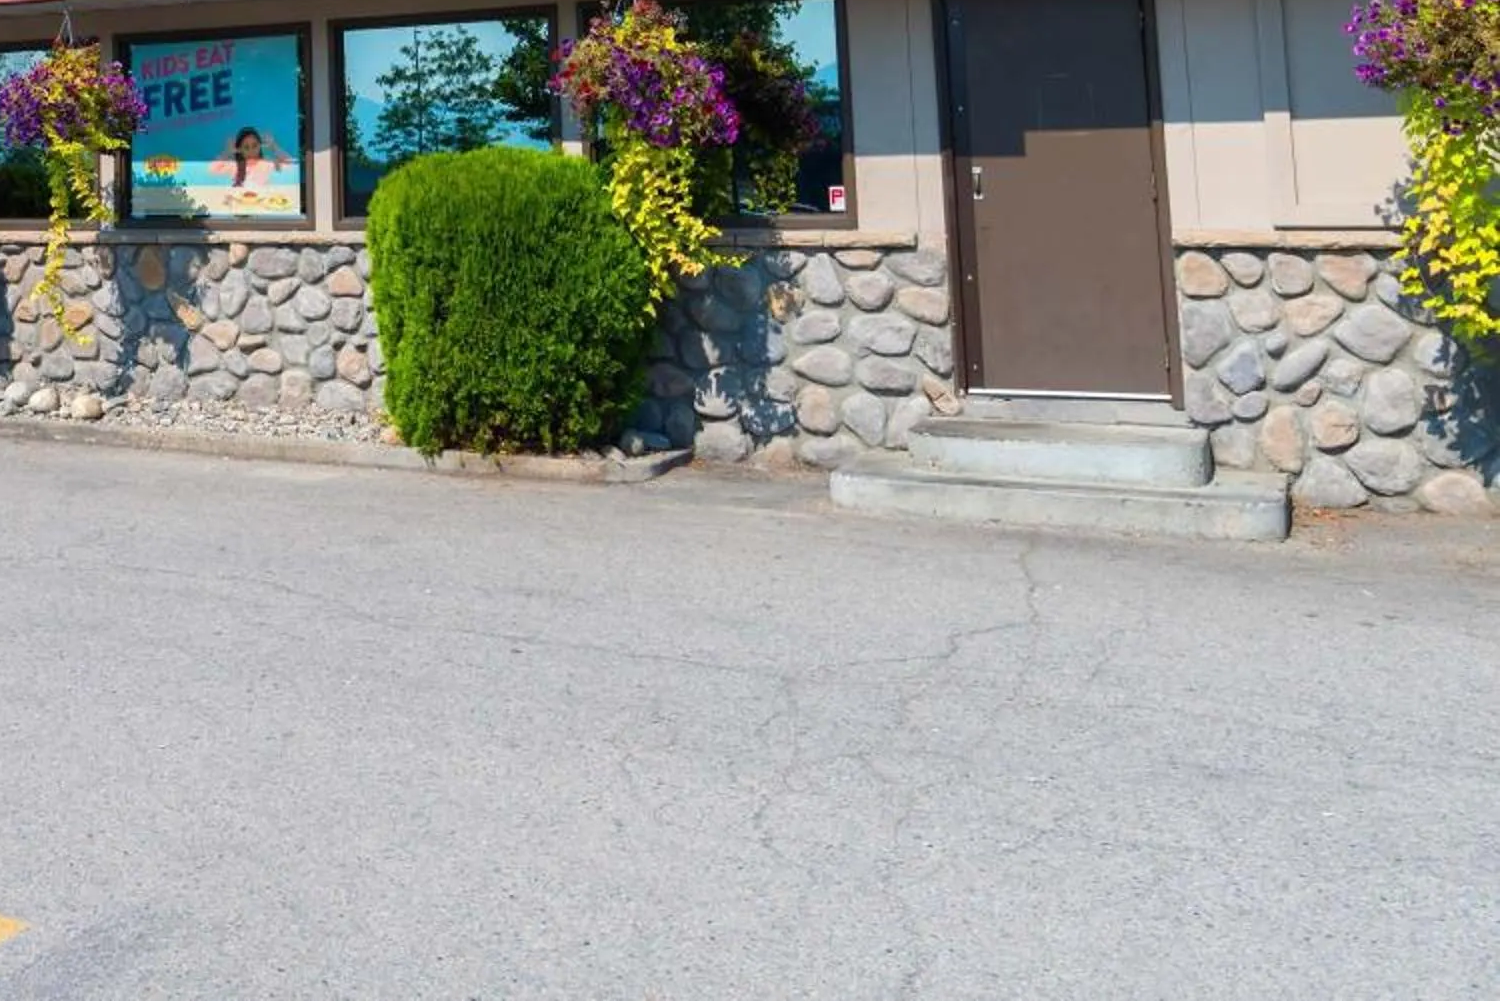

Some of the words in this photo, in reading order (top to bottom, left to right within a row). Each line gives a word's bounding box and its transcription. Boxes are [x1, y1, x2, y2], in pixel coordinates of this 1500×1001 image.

[141, 54, 189, 80] KIDS
[196, 40, 234, 69] EAT
[141, 69, 232, 118] FREE
